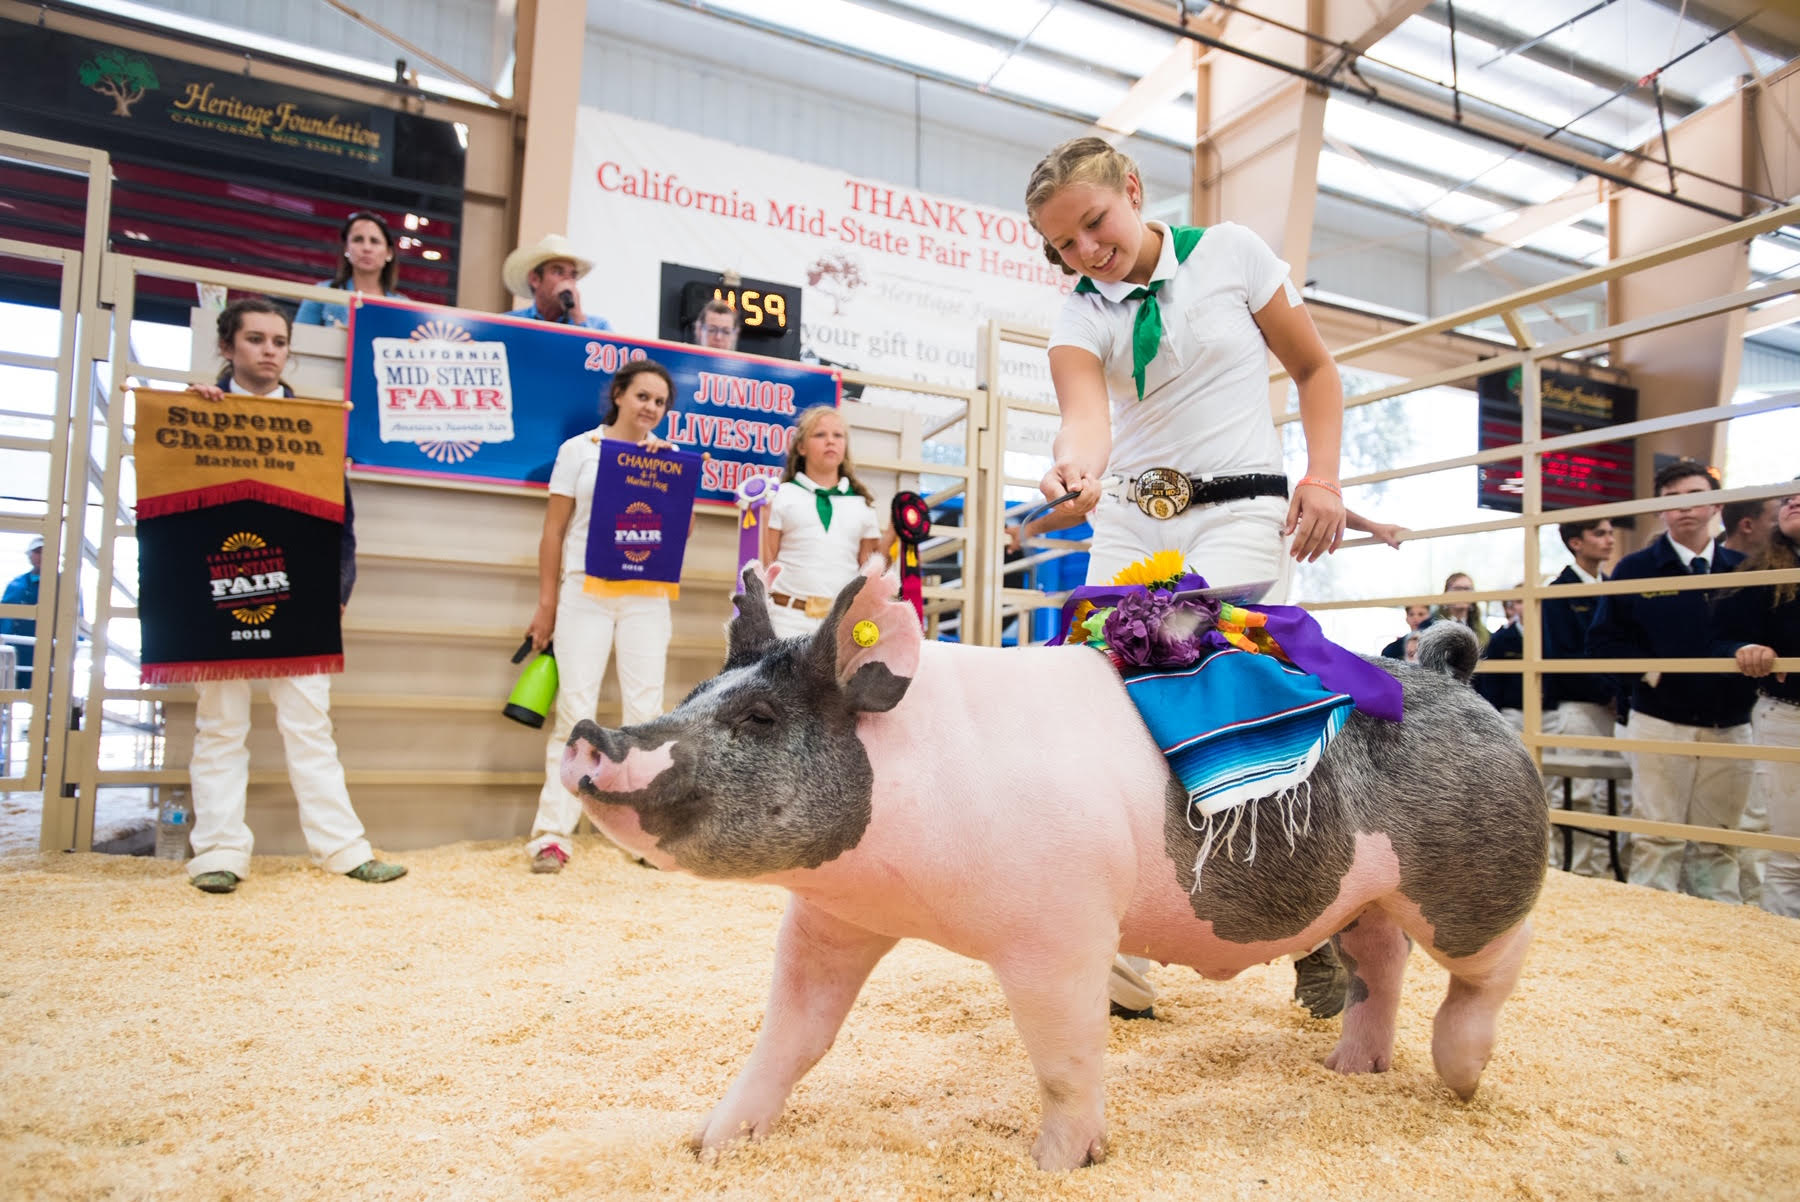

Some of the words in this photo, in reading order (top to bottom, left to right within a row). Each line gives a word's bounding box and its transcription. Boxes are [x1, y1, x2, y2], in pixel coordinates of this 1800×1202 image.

[171, 112, 265, 139] CALIFORNIA
[173, 82, 274, 129] Heritage
[273, 102, 380, 148] Foundation
[597, 161, 757, 222] California
[768, 199, 909, 256] Mid-State
[918, 234, 971, 268] Fair
[981, 248, 1077, 295] Heritag
[845, 180, 968, 235] THANK
[976, 210, 1041, 250] YOU
[383, 348, 500, 361] CALIFORNIA
[800, 323, 861, 348] your
[869, 329, 909, 358] gift
[916, 341, 941, 361] to
[946, 350, 976, 368] ou
[385, 365, 430, 385] MID
[436, 367, 503, 386] STATE
[385, 387, 506, 410] FAIR
[694, 371, 796, 415] JUNIOR
[168, 406, 313, 434] Supreme
[156, 428, 324, 455] Champion
[195, 454, 259, 468] Market
[264, 457, 295, 471] Hog
[617, 452, 683, 475] CHAMPION
[614, 529, 662, 541] FAIR
[210, 571, 290, 596] FAIR
[231, 629, 272, 641] 2018
